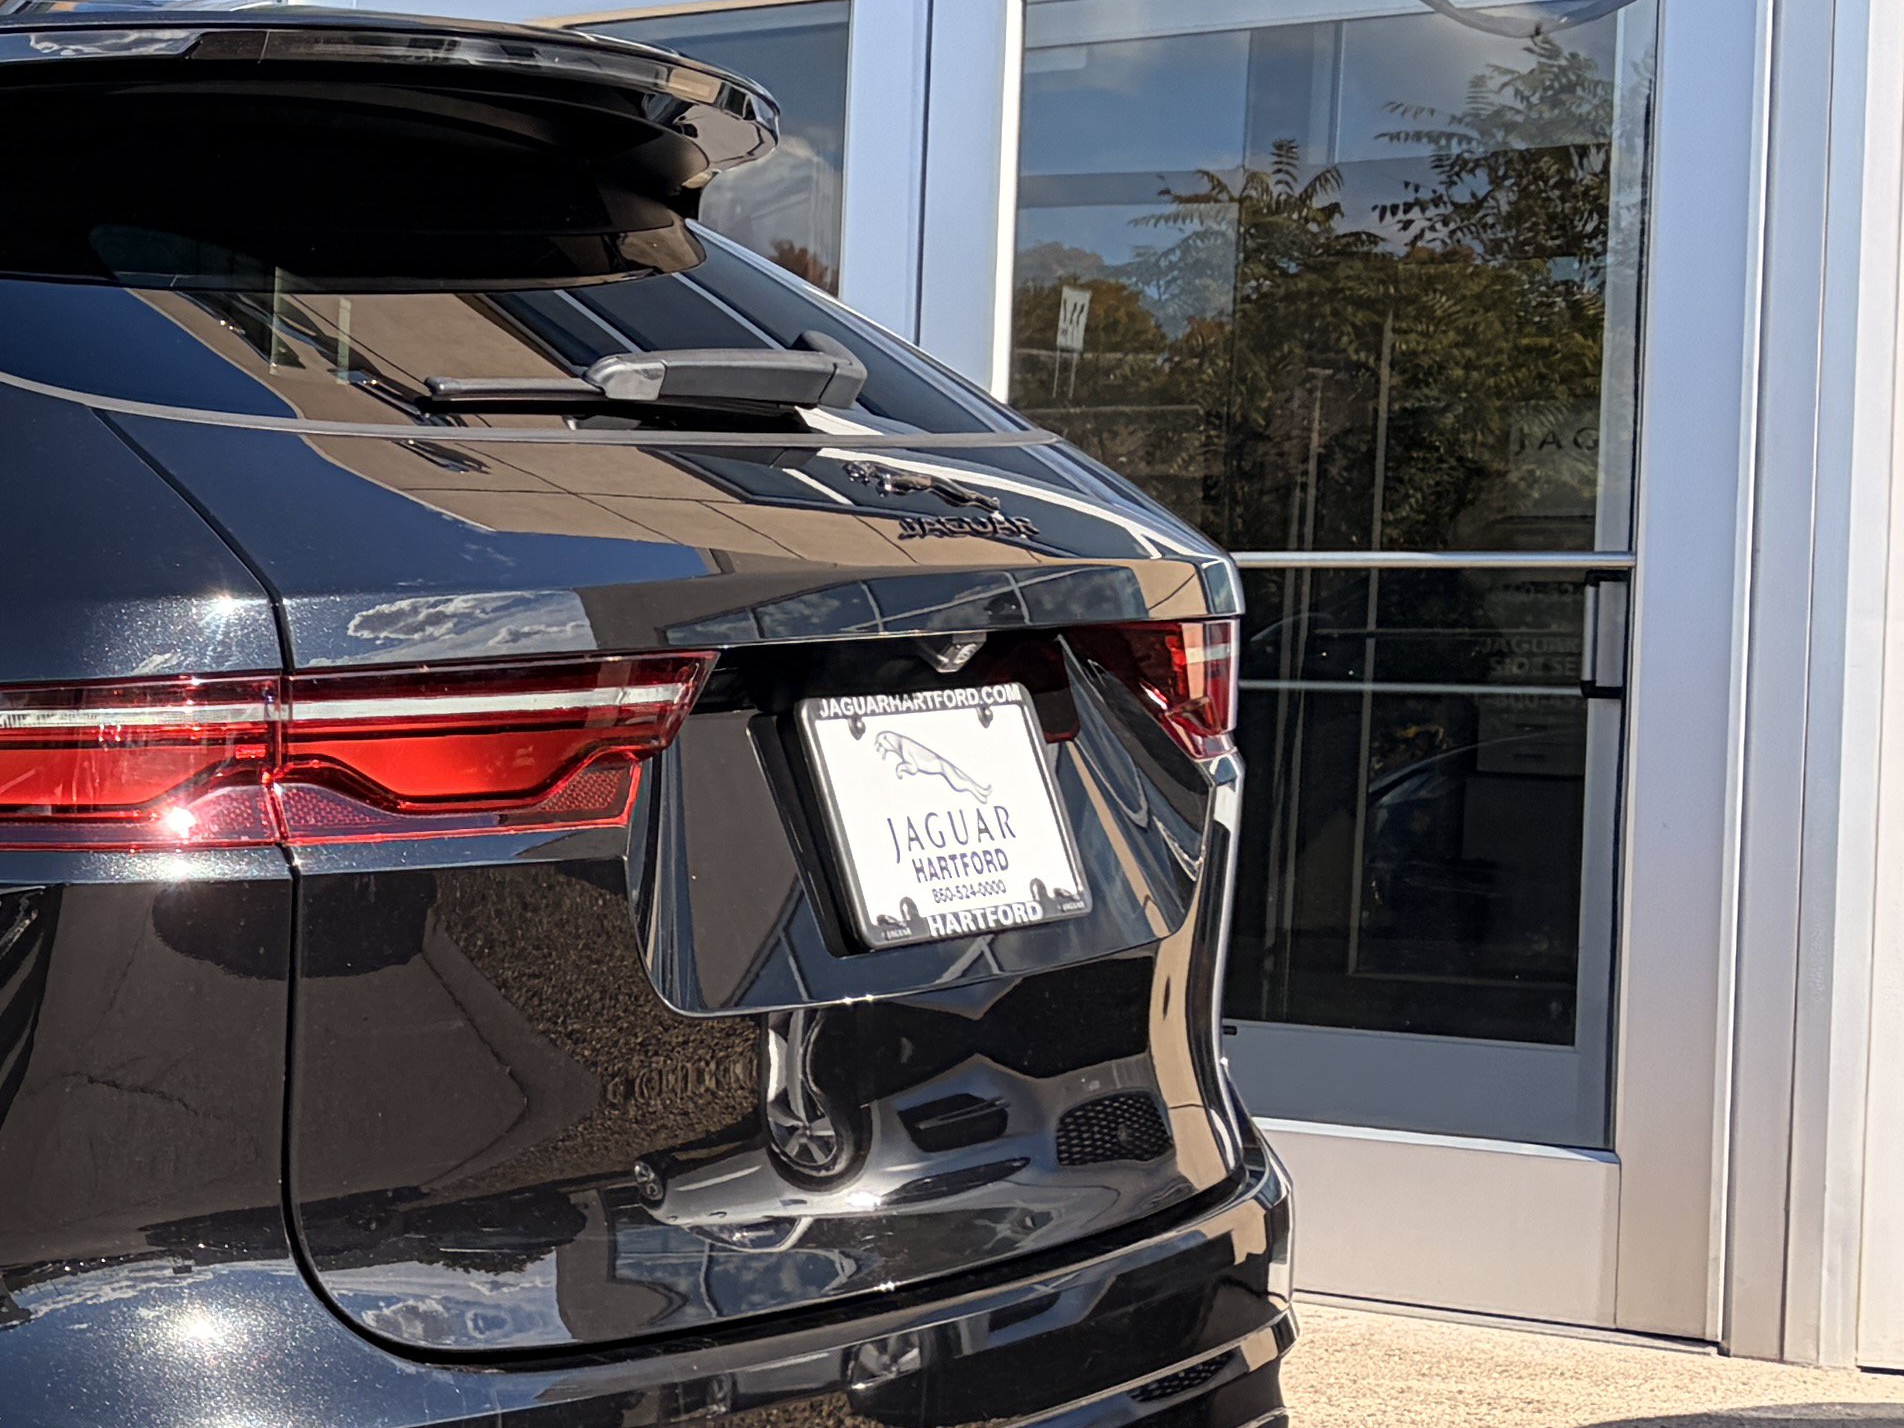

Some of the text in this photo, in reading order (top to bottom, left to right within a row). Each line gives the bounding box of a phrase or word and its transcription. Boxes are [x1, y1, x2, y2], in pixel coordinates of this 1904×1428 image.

[898, 516, 1041, 541] JAGUAR
[819, 683, 1023, 718] JAGUARHARTFORD.COM
[887, 805, 1016, 864] JAGUAR
[912, 848, 1009, 883] HARTFORD
[927, 901, 1043, 937] HARTFORD
